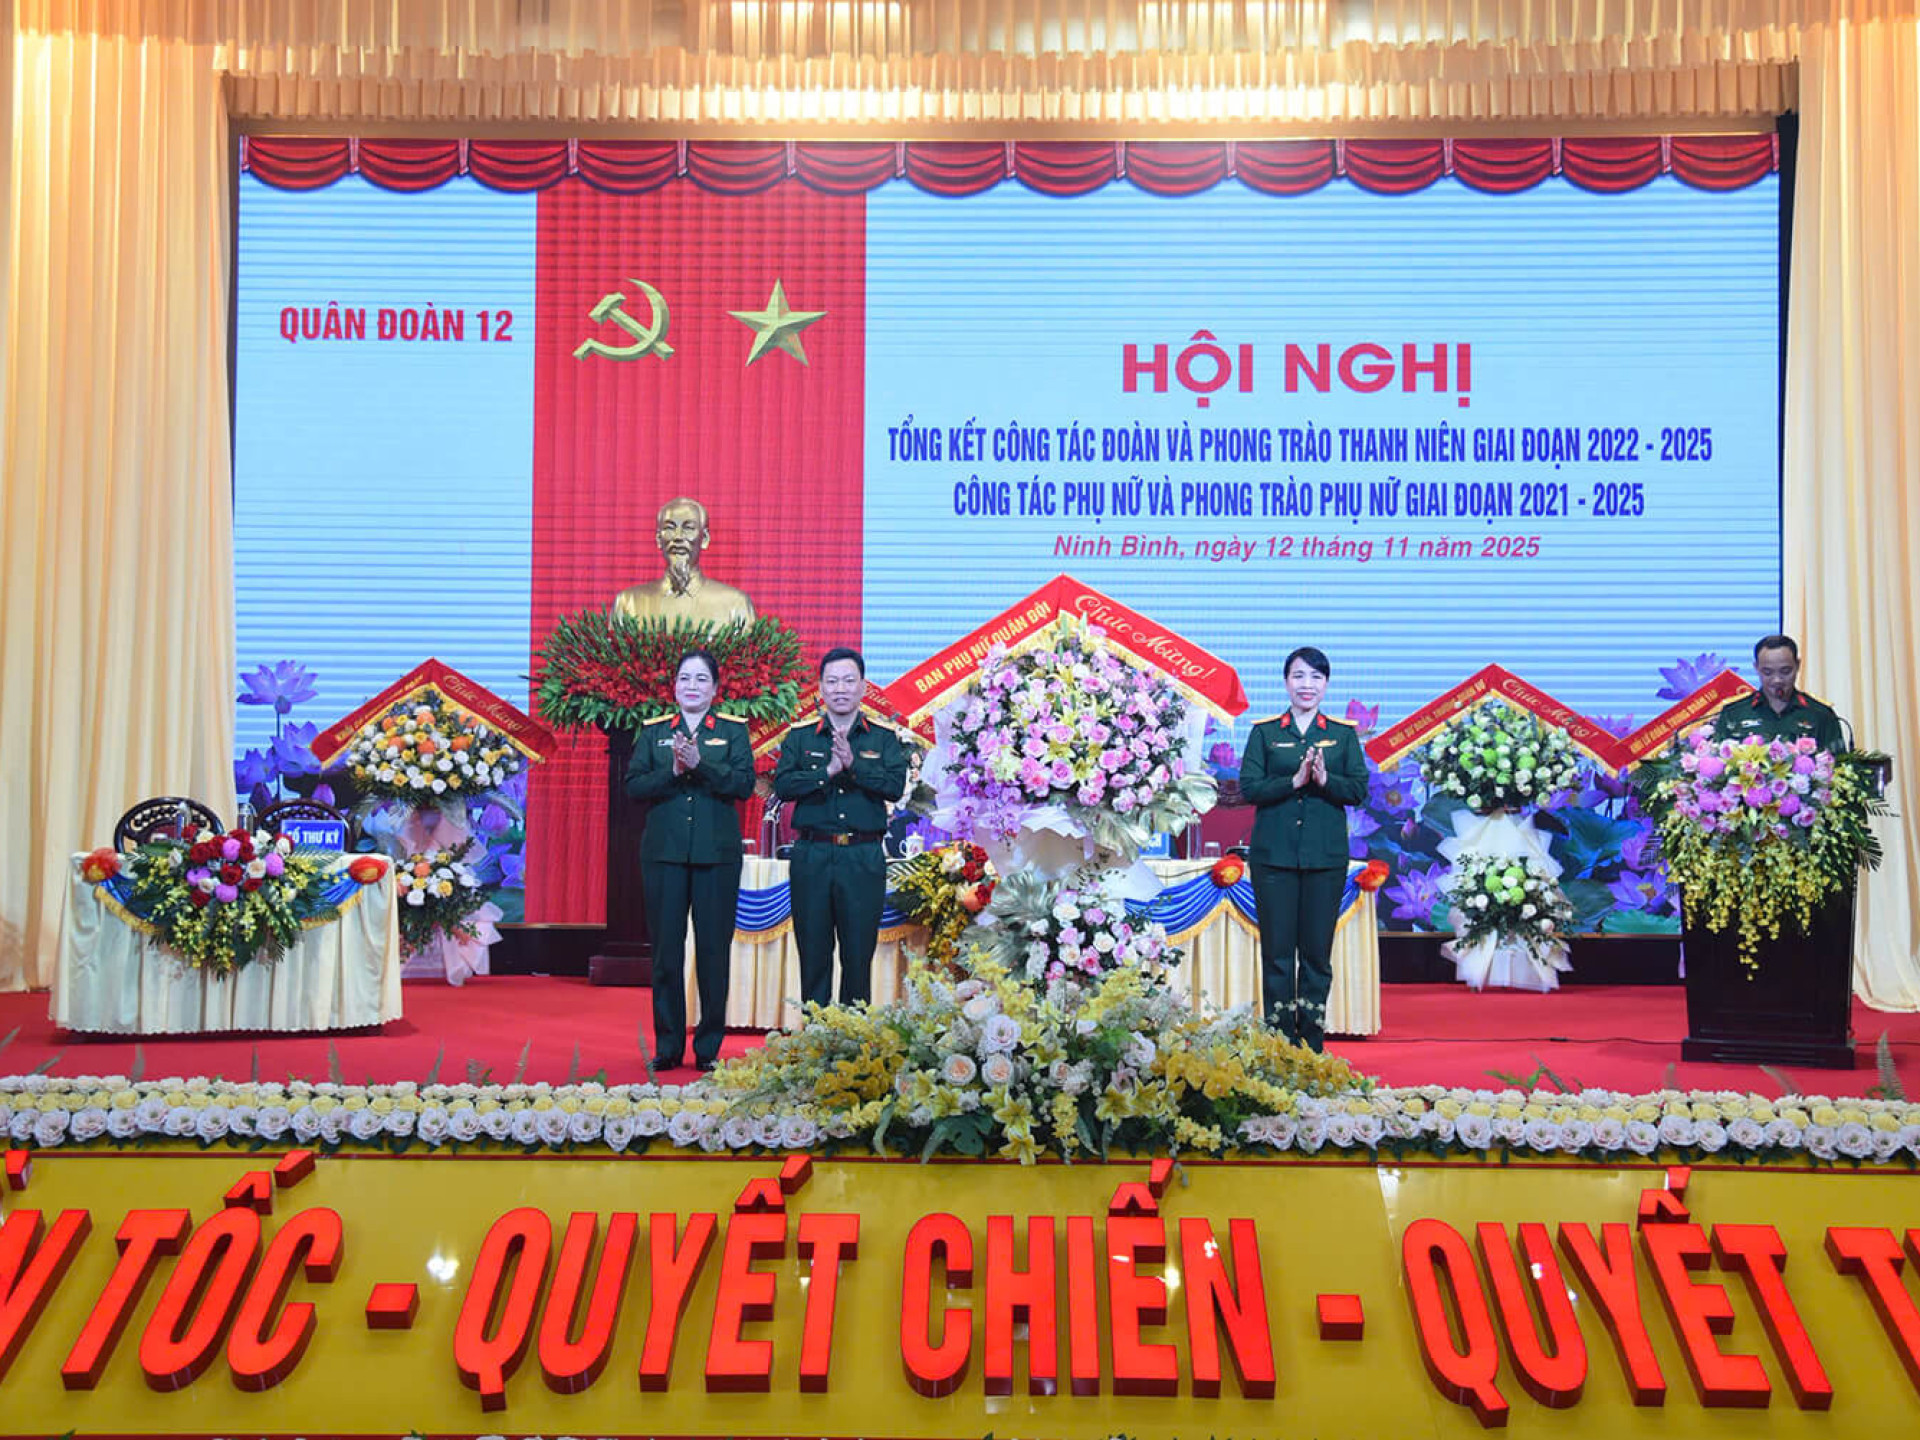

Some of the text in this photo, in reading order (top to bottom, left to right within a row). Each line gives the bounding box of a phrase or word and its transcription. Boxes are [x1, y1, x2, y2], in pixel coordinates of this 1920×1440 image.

[280, 301, 513, 343] QUÂN ĐOÀN 12
[1123, 329, 1472, 408] HỘI NGHỊ
[888, 414, 1713, 470] TỔNG KẾT CÔNG TÁC ĐOÀN VÀ PHONG TRÀO THANH NIÊN GIAI ĐOẠN 2022 - 2025
[953, 475, 1010, 516] CÔNG
[1016, 475, 1056, 516] TÁC
[1063, 482, 1105, 524] PHỤ
[1112, 475, 1143, 516] NỮ
[1148, 475, 1174, 516] VÀ
[1181, 482, 1253, 516] PHONG
[1260, 475, 1314, 516] TRÀO
[1320, 482, 1362, 525] PHỤ
[1369, 476, 1401, 516] NỮ
[1406, 482, 1447, 516] GIAI
[1454, 482, 1513, 525] ĐOẠN
[1519, 482, 1569, 516] 2021
[1592, 482, 1645, 517] 2025
[1053, 534, 1541, 563] Ninh Bình, ngày 12 tháng 11 năm 2025
[915, 667, 945, 694] BAN
[943, 649, 973, 677] PHỤ
[969, 635, 992, 659] NỮ
[1026, 600, 1052, 625] ĐỘI
[61, 1149, 343, 1393] TỐC
[365, 1283, 421, 1330] -
[453, 1154, 860, 1413] QUYẾT
[901, 1157, 1276, 1399] CHIẾN
[1316, 1294, 1364, 1341] -
[1401, 1166, 1833, 1430] QUYẾT
